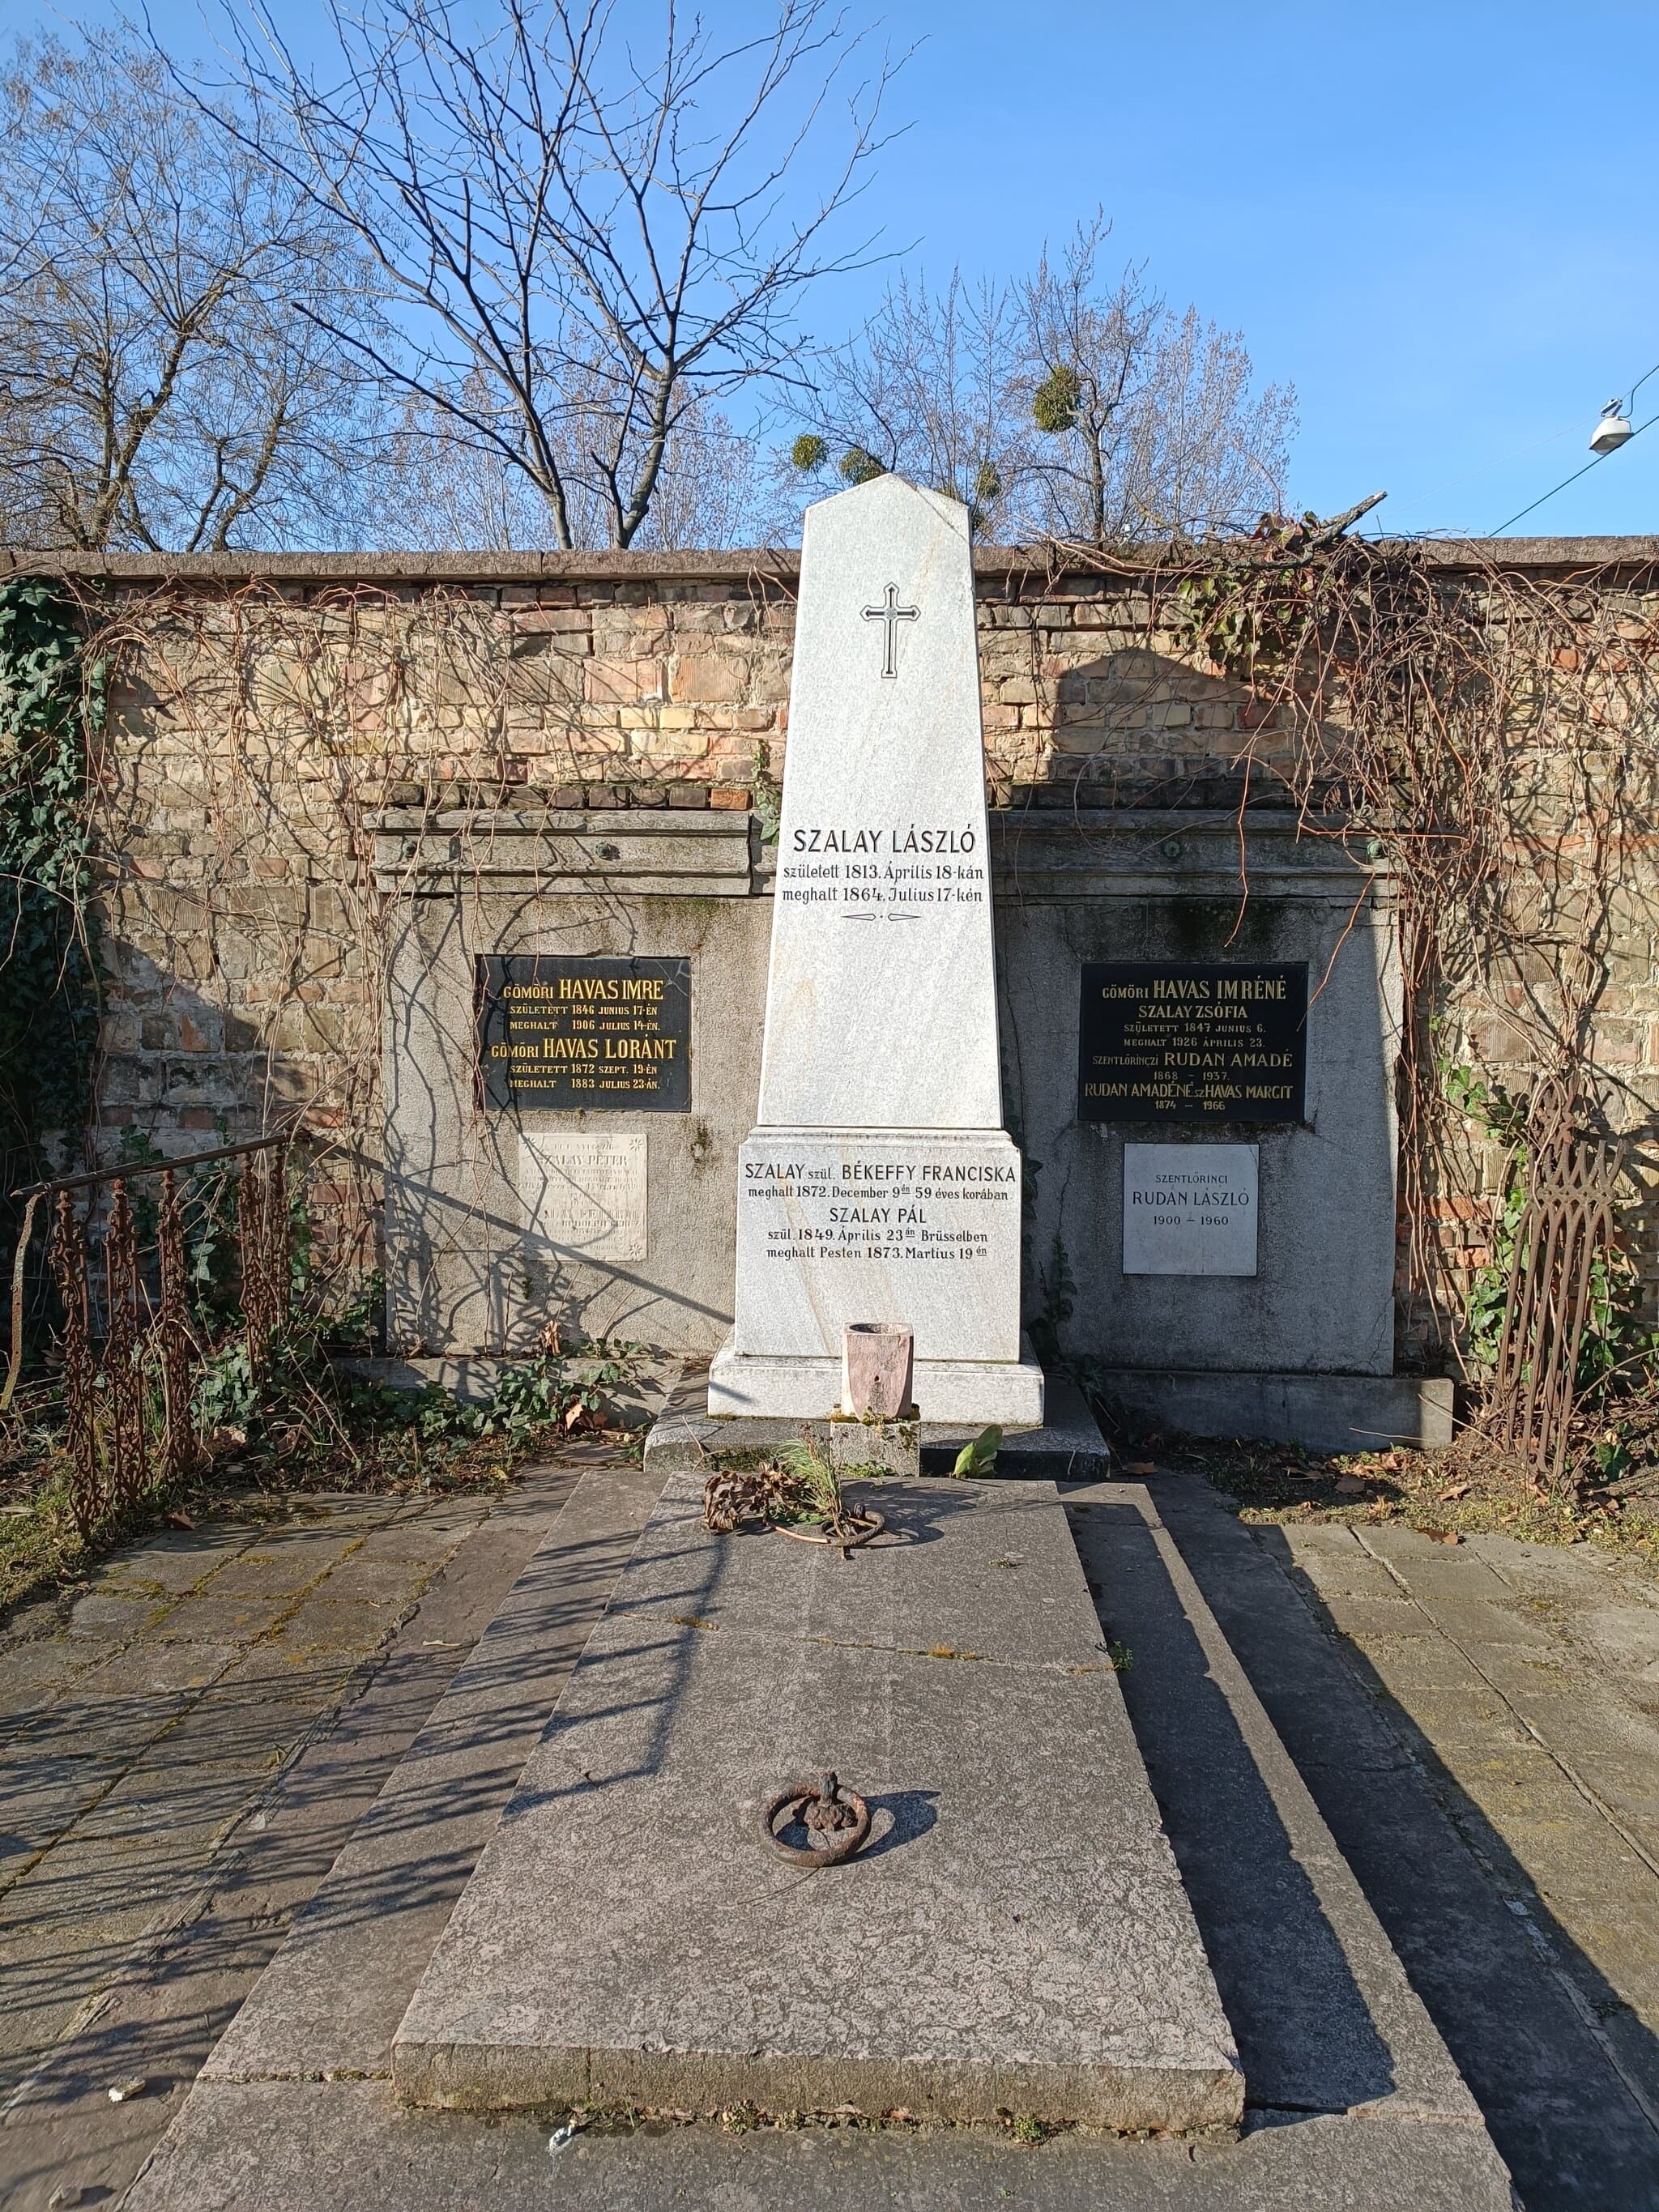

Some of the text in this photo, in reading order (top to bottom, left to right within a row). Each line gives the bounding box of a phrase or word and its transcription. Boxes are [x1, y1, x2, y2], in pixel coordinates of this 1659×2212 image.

[794, 824, 975, 852] SZALAY LÁSZLÓ
[783, 861, 983, 884] született 1813. Április 18-kán
[783, 888, 983, 904] meghalt 1864. Julius 17-kén
[559, 979, 618, 999] HAVAS
[622, 980, 663, 1000] IMRE
[1154, 980, 1210, 999] HAVAS
[1218, 975, 1286, 999] IMRÉNÉ
[572, 1005, 595, 1015] 1846
[599, 1007, 629, 1015] JUNIUS
[1139, 1002, 1247, 1018] SZALAY ZSÓFIA
[510, 1021, 558, 1030] MEGHALT
[572, 1021, 595, 1030] 1906
[599, 1021, 630, 1030] JULIUS
[1185, 1023, 1210, 1033] 1847
[1215, 1025, 1251, 1033] JUNIUS
[1257, 1024, 1265, 1033] 6.
[543, 1038, 598, 1059] HAVAS
[605, 1034, 677, 1059] LORÁNT
[1124, 1037, 1265, 1047] MEGHALT 1926 ÁPRILIS 23.
[1164, 1053, 1225, 1067] RUDAN
[1231, 1049, 1292, 1068] AMADÉ
[572, 1064, 595, 1074] 1872
[599, 1066, 629, 1074] SZEPT.
[1154, 1072, 1178, 1080] 1868
[510, 1080, 557, 1089] MEGHALT
[572, 1079, 595, 1089] 1883
[599, 1080, 630, 1089] JULIUS
[1085, 1084, 1128, 1097] RUDAN
[1132, 1081, 1194, 1097] AMADÉNÉ
[1205, 1084, 1242, 1098] HAVAS
[1246, 1085, 1293, 1099] MARGIT
[1155, 1101, 1175, 1109] 1874
[1203, 1101, 1225, 1110] 1966
[745, 1160, 1016, 1182] SZALAY szül. BÉKEFFY FRANCISKA
[748, 1187, 793, 1200] meghalt
[796, 1186, 830, 1197] 1872.
[832, 1187, 888, 1198] December
[915, 1189, 932, 1199] 59
[936, 1187, 959, 1200] éves
[962, 1189, 1008, 1200] korában
[1194, 1187, 1249, 1205] LÁSZLÓ
[830, 1205, 927, 1223] SZALAY PÁL
[1154, 1216, 1181, 1225] 1900
[1201, 1217, 1229, 1225] 1960
[768, 1230, 795, 1241] szül.
[798, 1229, 835, 1241] 1849.
[838, 1225, 881, 1248] Április
[921, 1230, 987, 1242] Brüsselben
[766, 1247, 815, 1262] meghalt
[820, 1247, 861, 1258] Pesten
[867, 1248, 903, 1259] 1873.
[906, 1248, 955, 1259] Martius
